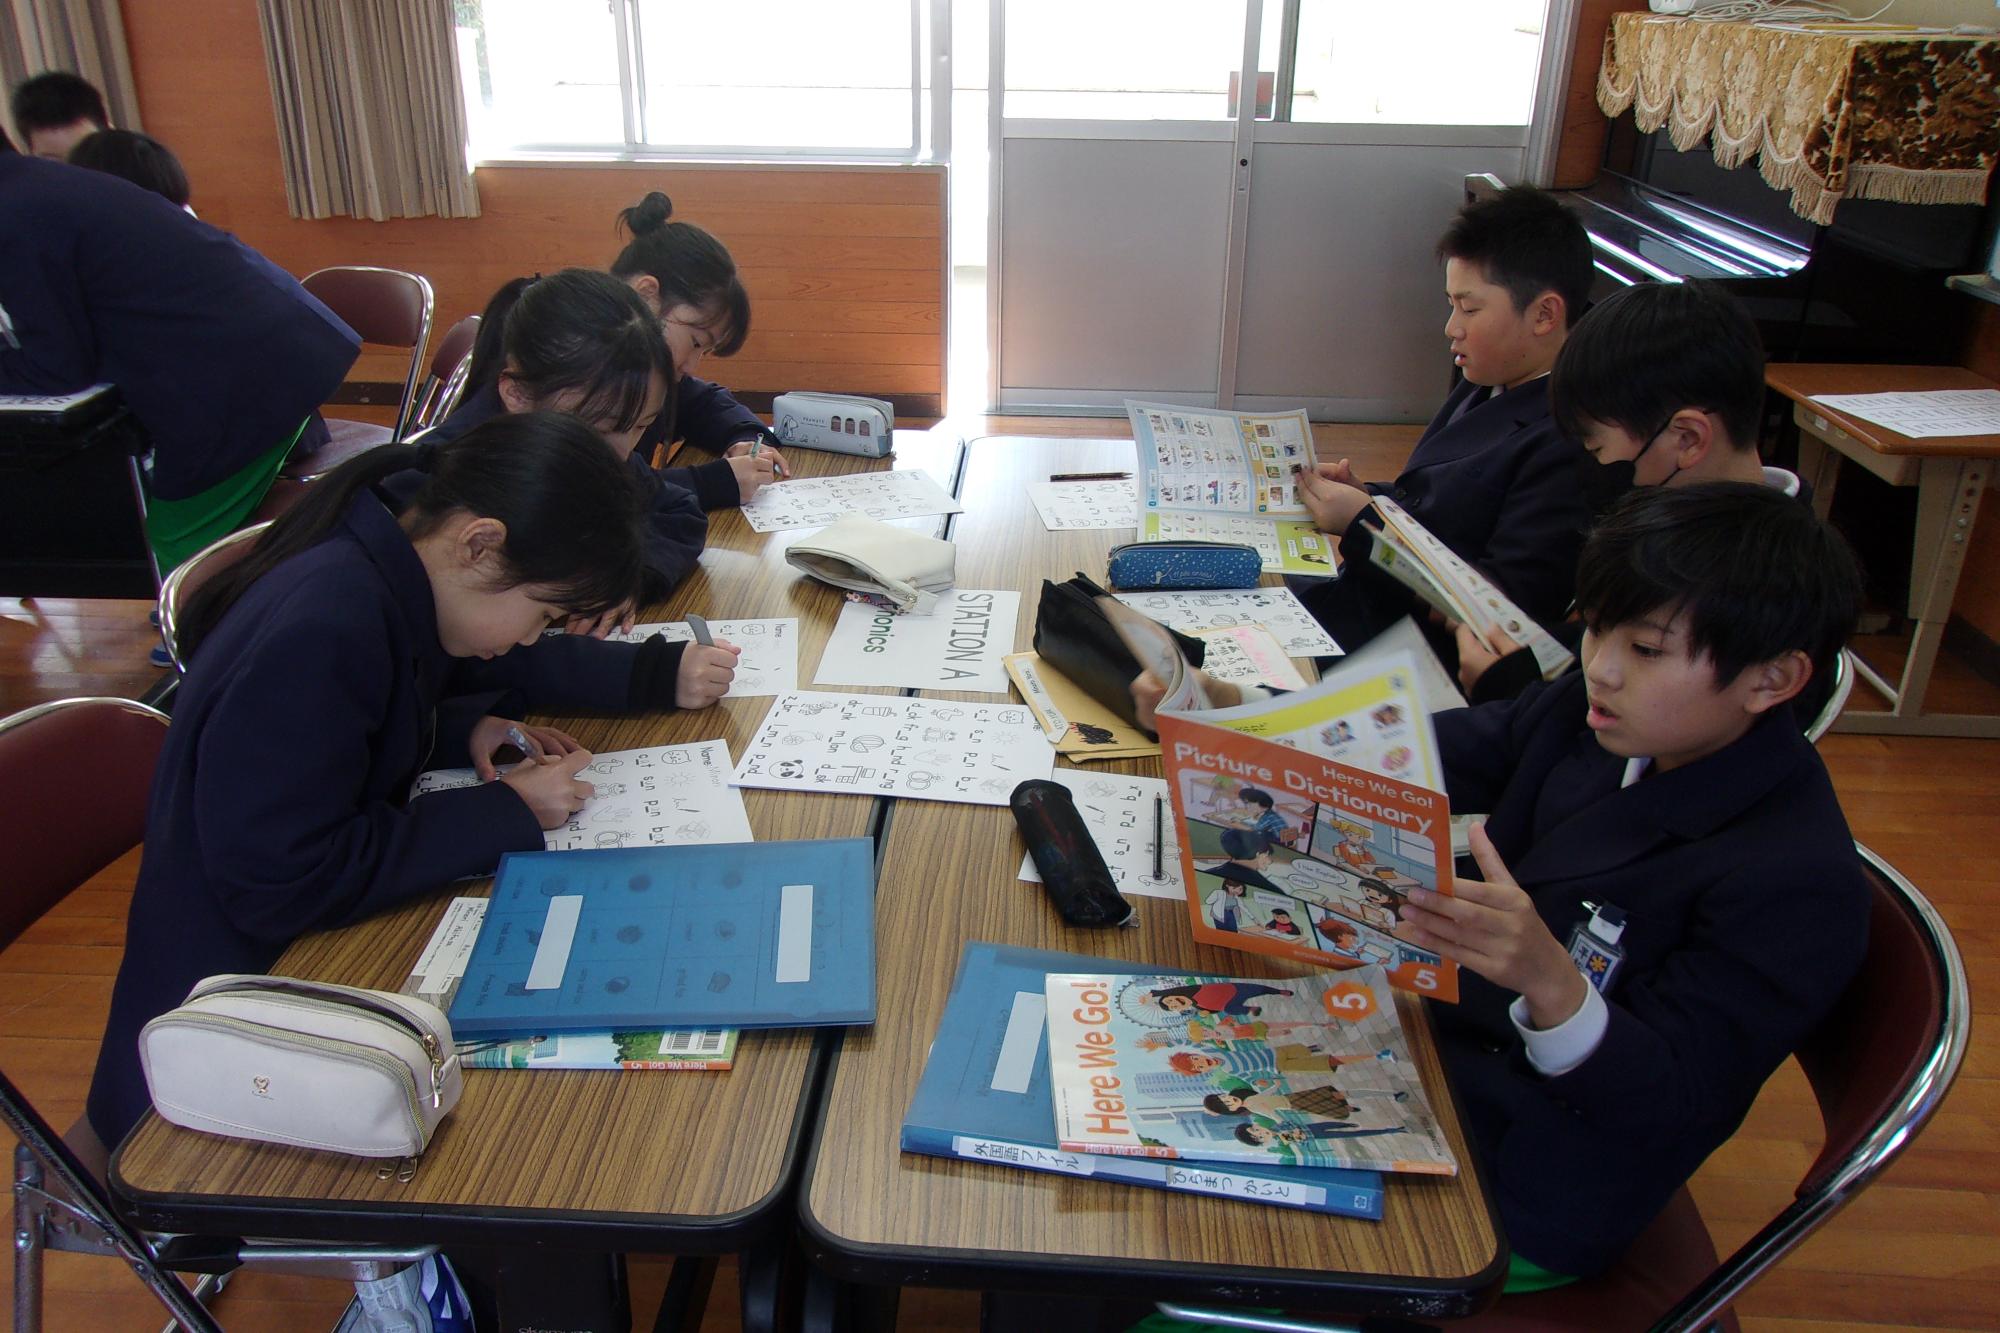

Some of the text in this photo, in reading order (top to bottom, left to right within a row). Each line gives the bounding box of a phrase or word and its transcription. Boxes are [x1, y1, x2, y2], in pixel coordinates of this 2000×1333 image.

[939, 593, 994, 680] STATION A
[906, 702, 927, 720] d_ck
[974, 709, 991, 723] c_t
[827, 731, 847, 753] m_lon
[895, 723, 919, 741] fr_g
[969, 729, 984, 744] s_n
[891, 745, 912, 766] h_nd
[963, 752, 978, 768] p_n
[1173, 741, 1433, 835] Picture Dictionary
[1322, 765, 1433, 809] Here We Go!
[1413, 968, 1437, 990] 5
[1331, 992, 1369, 1011] 5
[631, 1061, 643, 1069] 5
[1071, 981, 1130, 1136] Here We Go!
[973, 1143, 1079, 1171] 外国語ファイル
[1085, 1143, 1111, 1155] Here
[1129, 1145, 1149, 1156] Go!
[1155, 1146, 1168, 1158] 5
[1172, 1166, 1291, 1198] ひらまつ かいと
